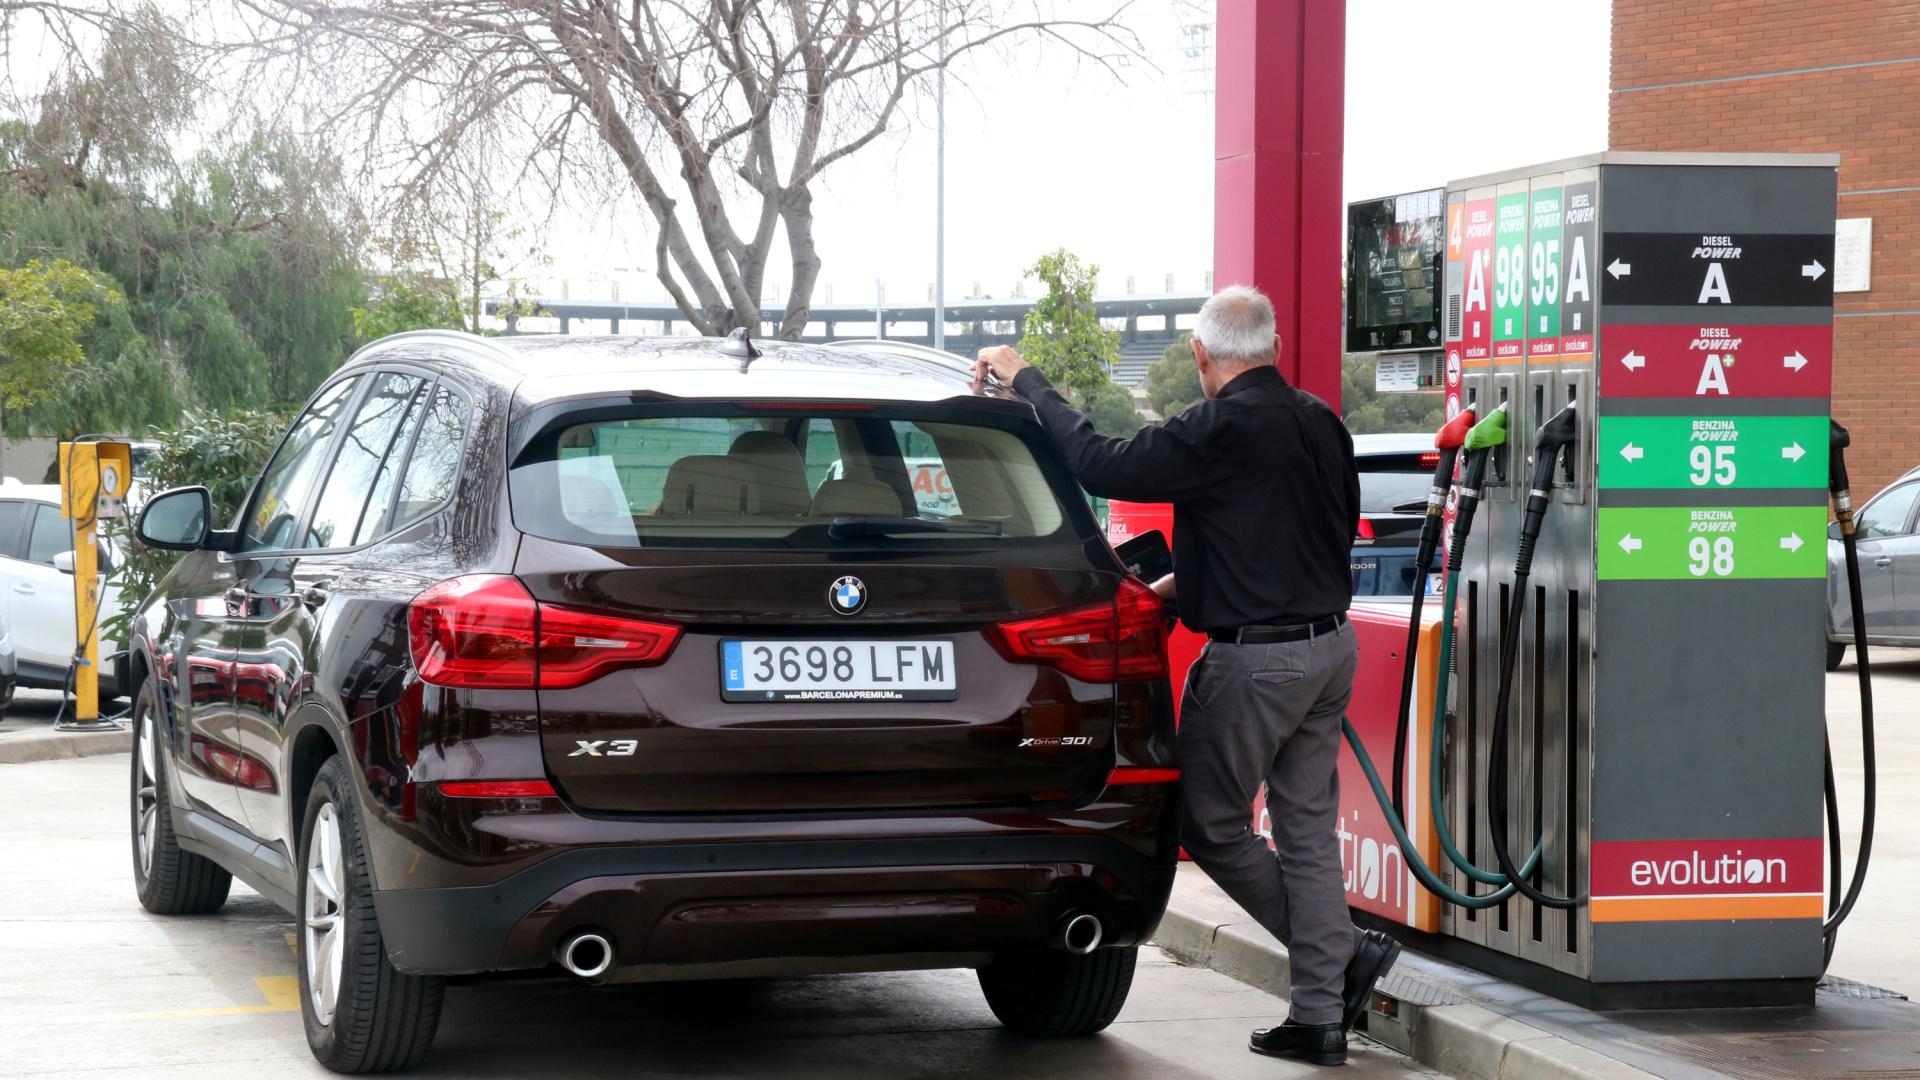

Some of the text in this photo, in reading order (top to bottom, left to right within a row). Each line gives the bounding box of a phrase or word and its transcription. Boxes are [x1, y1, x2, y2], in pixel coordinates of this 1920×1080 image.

[1572, 194, 1590, 208] DIESEL
[1532, 213, 1561, 230] POWER
[1565, 207, 1594, 225] POWER
[1450, 209, 1462, 254] 4
[1702, 236, 1733, 246] DIESEL
[1692, 247, 1742, 259] POWER
[1496, 244, 1524, 309] 98
[1531, 239, 1559, 306] 95
[1565, 236, 1590, 304] A
[1697, 263, 1732, 304] A
[1700, 328, 1731, 338] DIESEL
[1692, 420, 1735, 430] BENZINA
[1690, 431, 1738, 442] POWER
[1689, 445, 1736, 486] 95
[1691, 510, 1733, 520] BENZINA
[1688, 521, 1737, 532] POWER
[1688, 536, 1734, 576] 98
[753, 645, 945, 682] 3698 LFM
[730, 669, 739, 680] E
[784, 691, 903, 699] www.BARCELONAPREMIUM.es
[567, 740, 639, 757] X3
[1631, 850, 1786, 886] evolution
